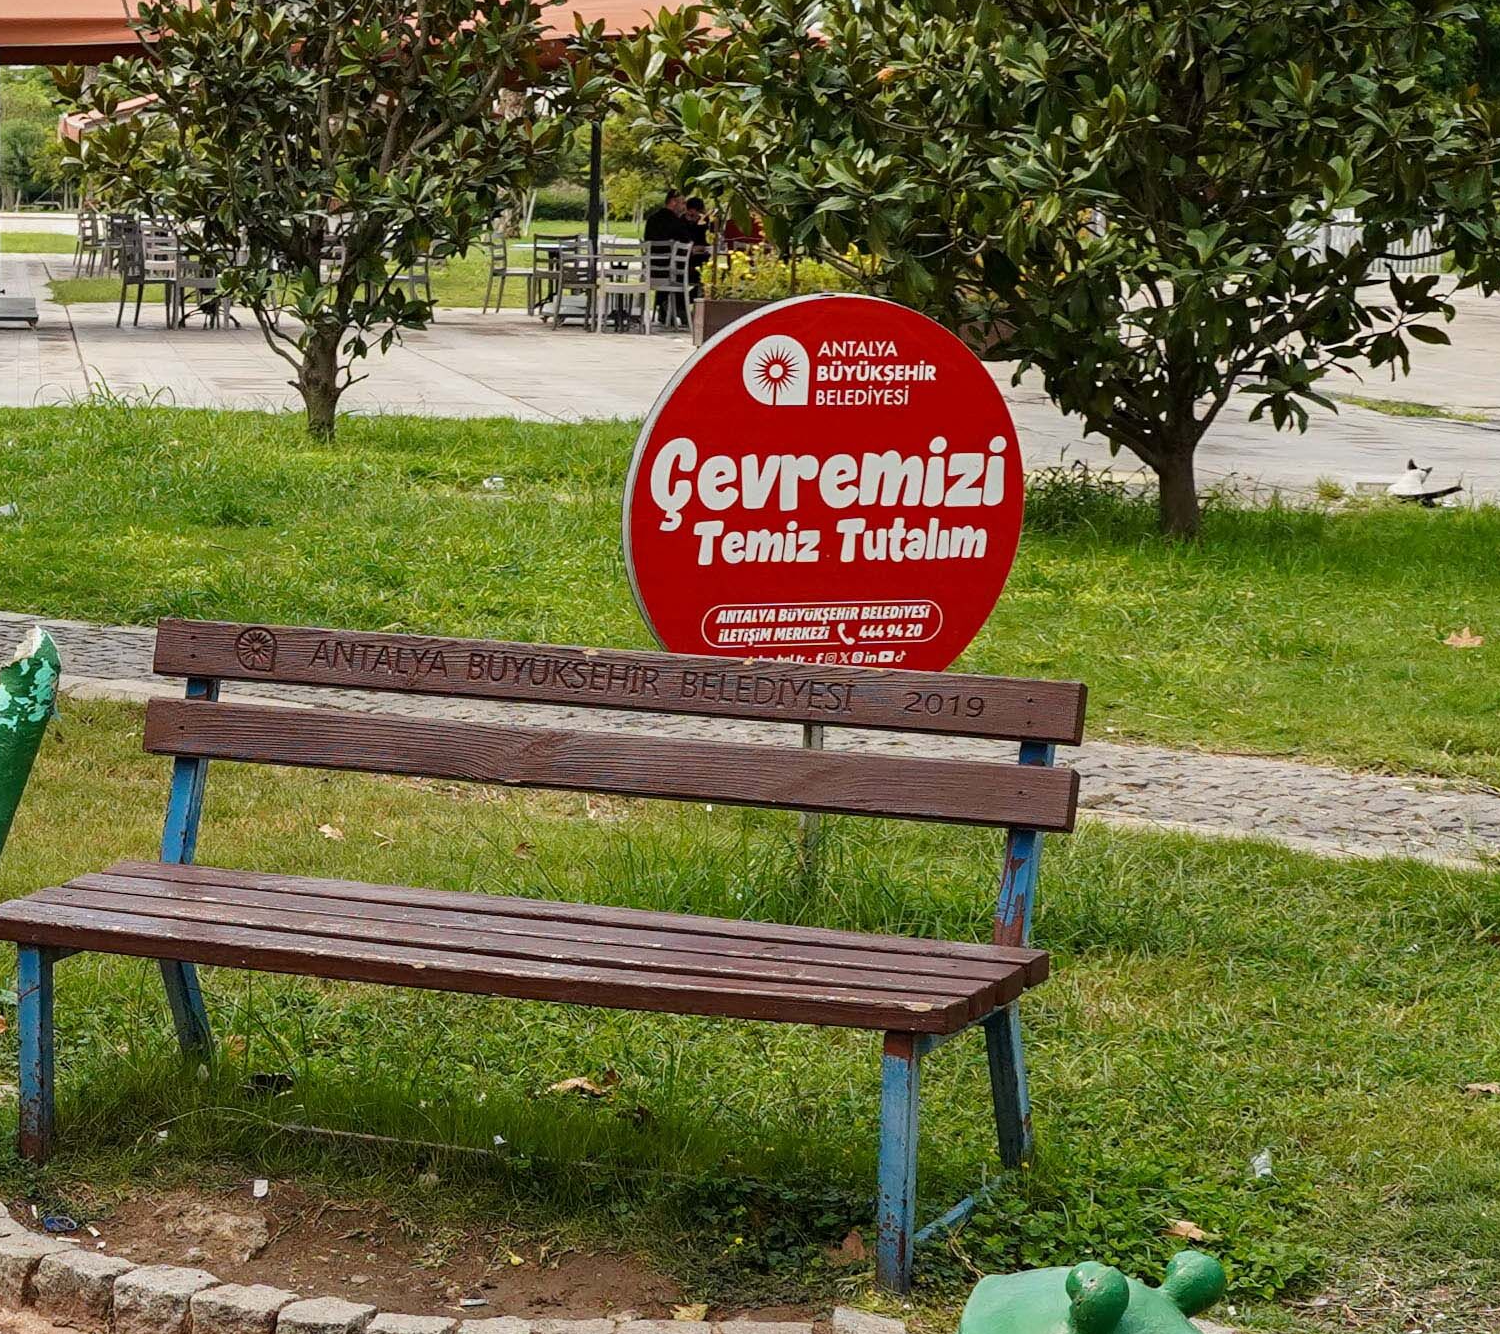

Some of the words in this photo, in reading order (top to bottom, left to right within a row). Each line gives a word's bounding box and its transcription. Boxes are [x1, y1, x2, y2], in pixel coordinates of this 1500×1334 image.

[817, 340, 898, 357] ANTALYA
[816, 360, 937, 385] BÜYÜKŞEHİR
[815, 385, 909, 405] BELEDİYESİ
[650, 436, 1007, 531] Çevremizi
[693, 520, 821, 566] Temiz
[836, 517, 988, 563] Tutalım
[715, 609, 776, 624] ANTALYA
[777, 605, 859, 624] BÜYÜKŞEHİR
[861, 604, 931, 620] BELEDİYESİ
[718, 627, 772, 646] İLETİŞİM
[773, 625, 831, 641] MERKEZİ
[859, 624, 884, 638] 444
[886, 624, 904, 638] 94
[905, 624, 923, 637] 20
[309, 640, 449, 679] ANTALYA
[680, 671, 854, 713] BELEDİYESİ
[903, 691, 985, 718] 2019
